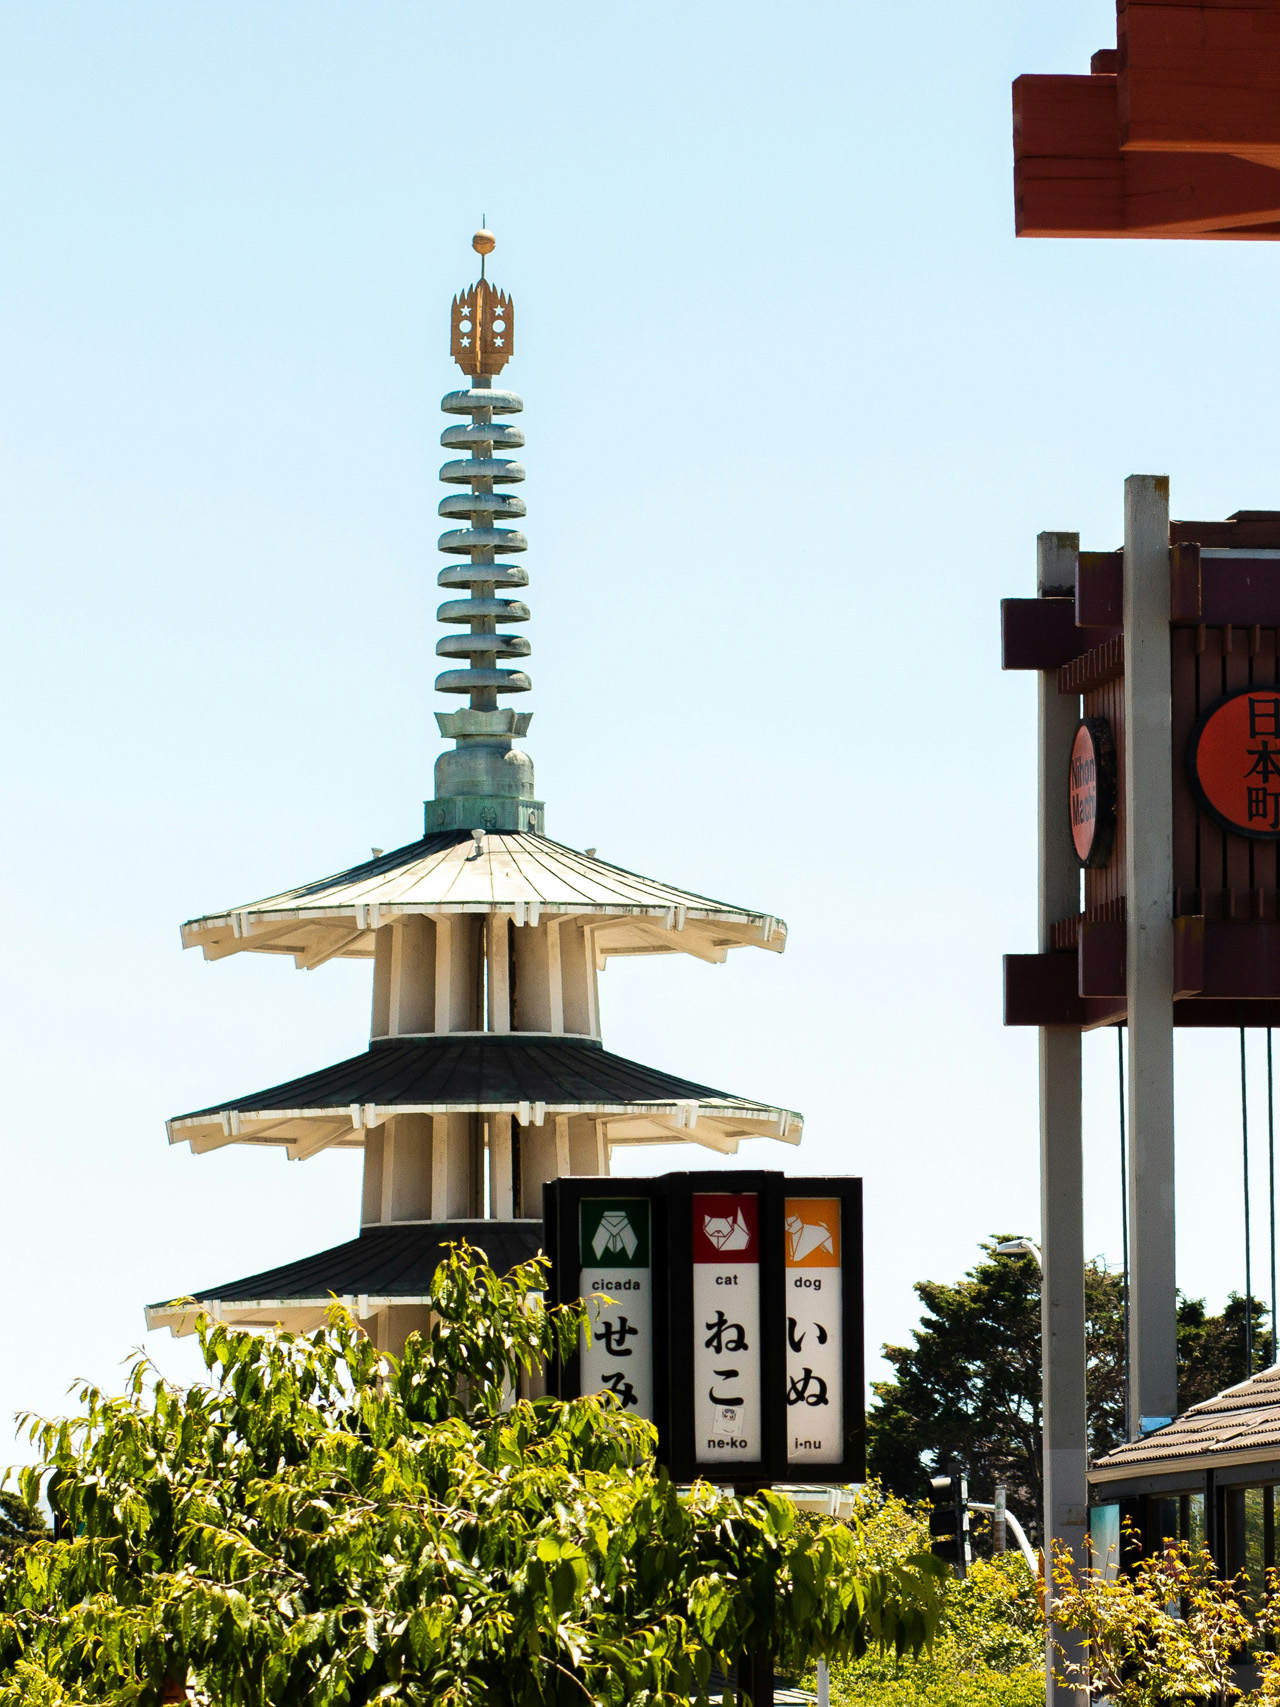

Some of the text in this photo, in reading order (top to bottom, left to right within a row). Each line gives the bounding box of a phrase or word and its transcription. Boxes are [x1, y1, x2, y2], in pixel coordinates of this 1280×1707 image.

[1071, 755, 1096, 790] Nihon
[1072, 787, 1096, 827] Machi
[592, 1278, 641, 1291] cicada
[715, 1275, 739, 1286] cat
[794, 1276, 822, 1291] dog
[594, 1316, 639, 1411] せみ
[704, 1310, 749, 1407] ねこ
[787, 1316, 829, 1407] いぬ
